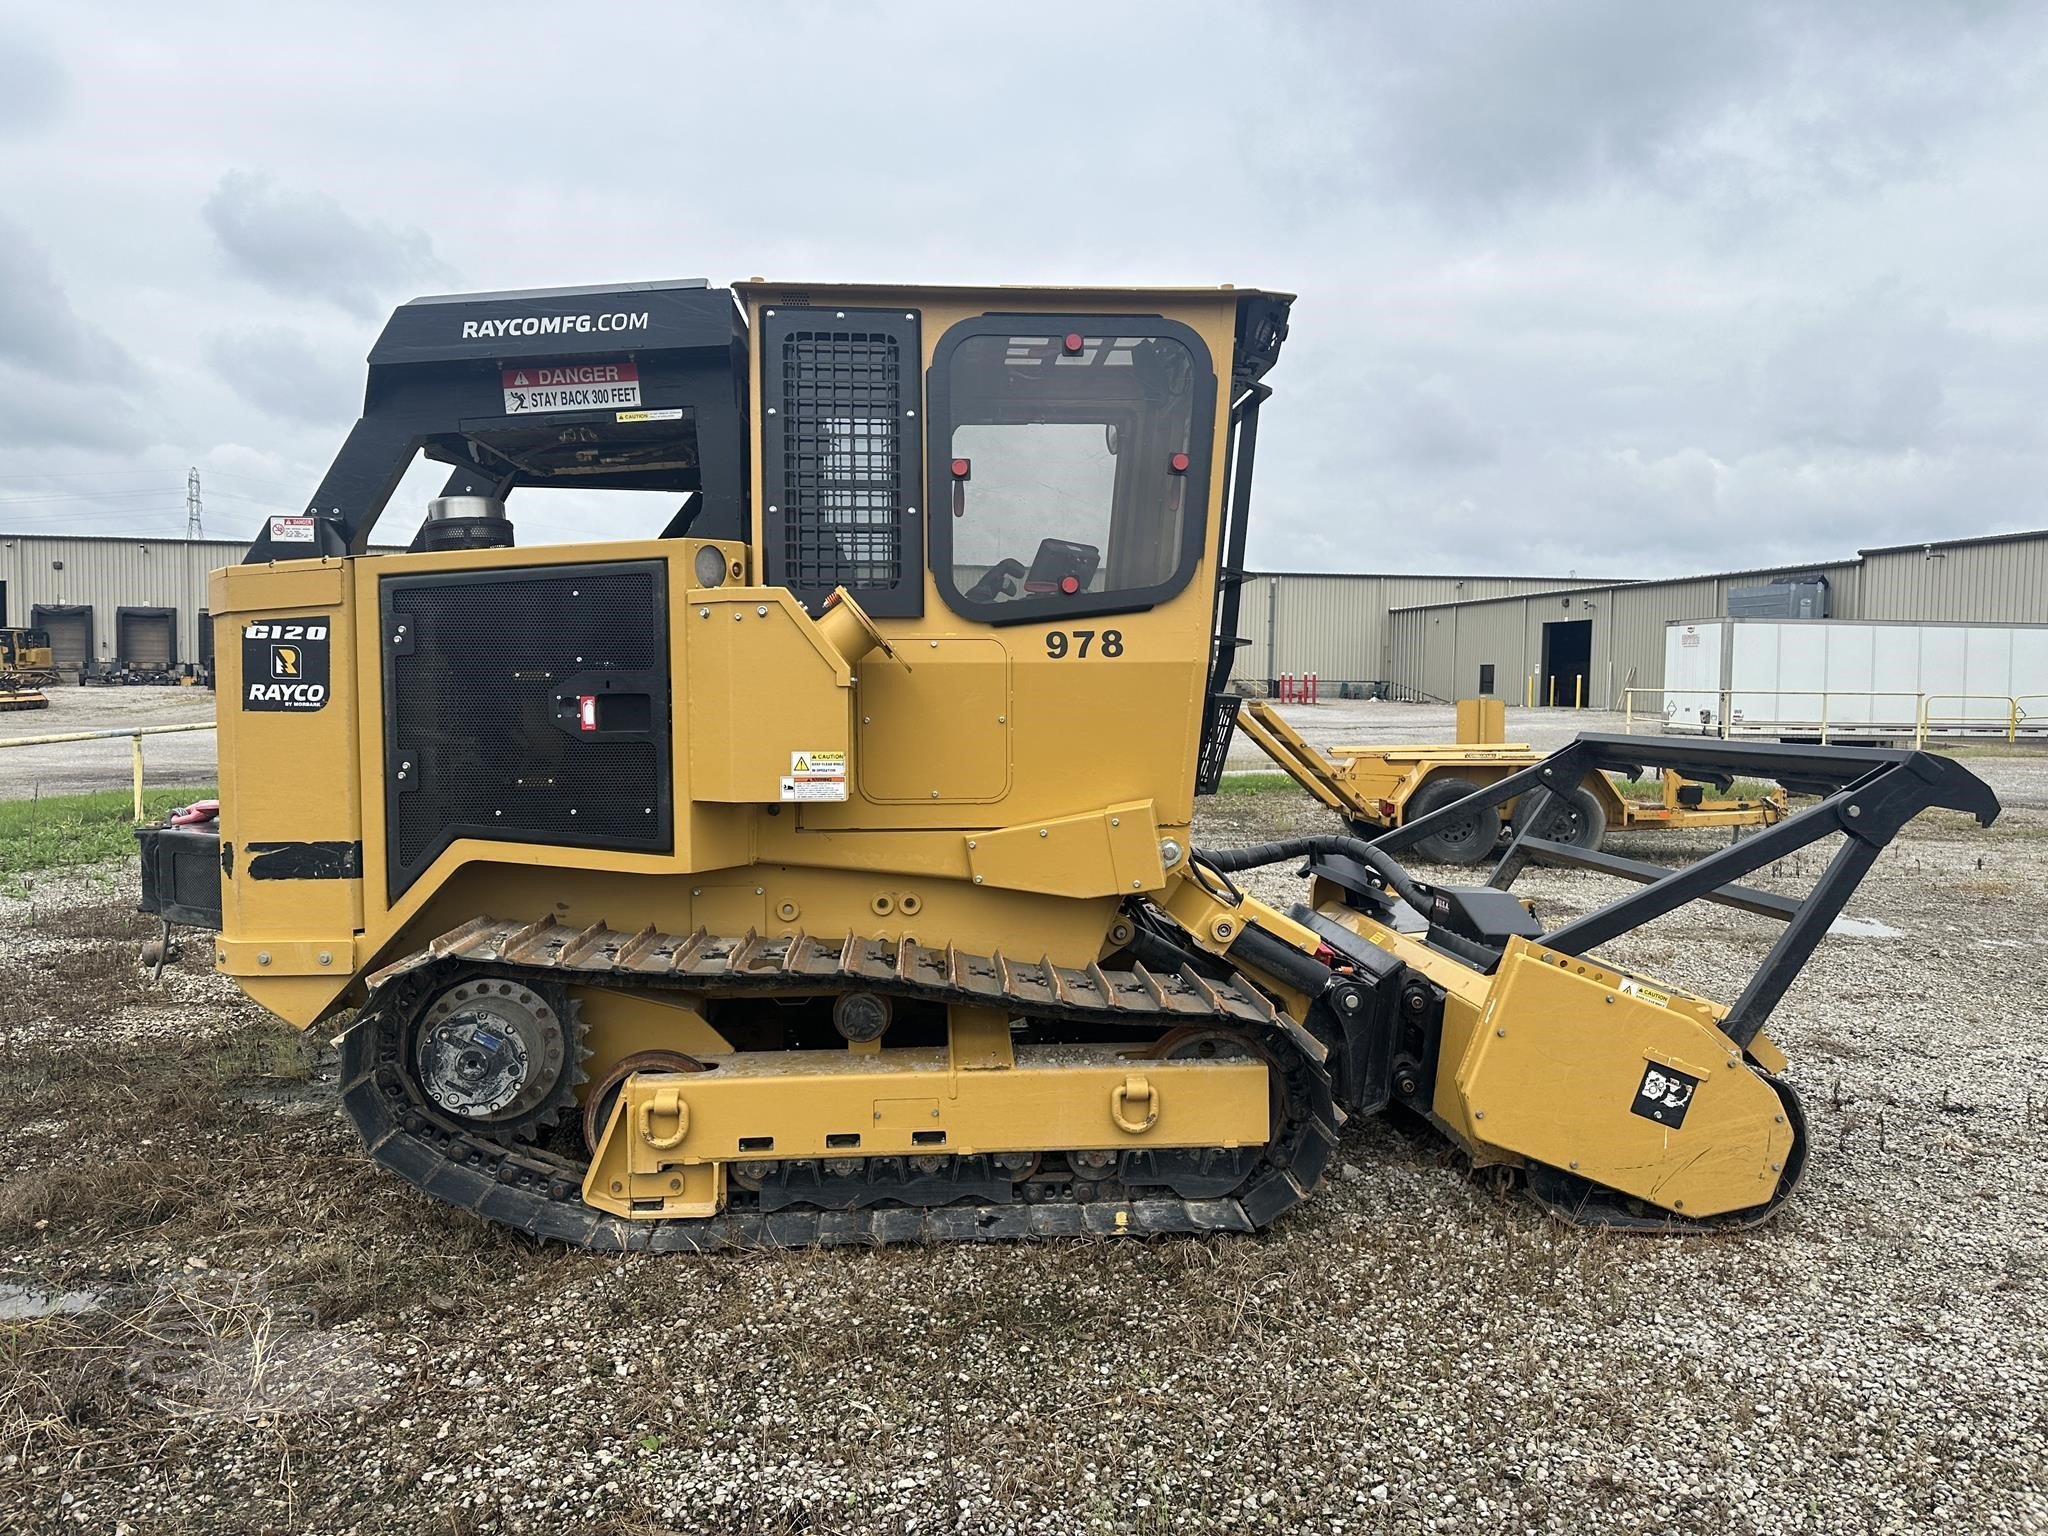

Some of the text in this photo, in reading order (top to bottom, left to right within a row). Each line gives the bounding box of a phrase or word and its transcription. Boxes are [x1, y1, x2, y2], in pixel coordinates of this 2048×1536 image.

[462, 312, 649, 339] RAYCOMFG.COM
[538, 366, 619, 385] DANGER
[531, 387, 637, 408] STAY BACK 300 FEET
[245, 625, 327, 641] C120
[1045, 629, 1124, 659] 978
[248, 684, 325, 702] RAYCO
[1644, 989, 1668, 1001] CAUTION
